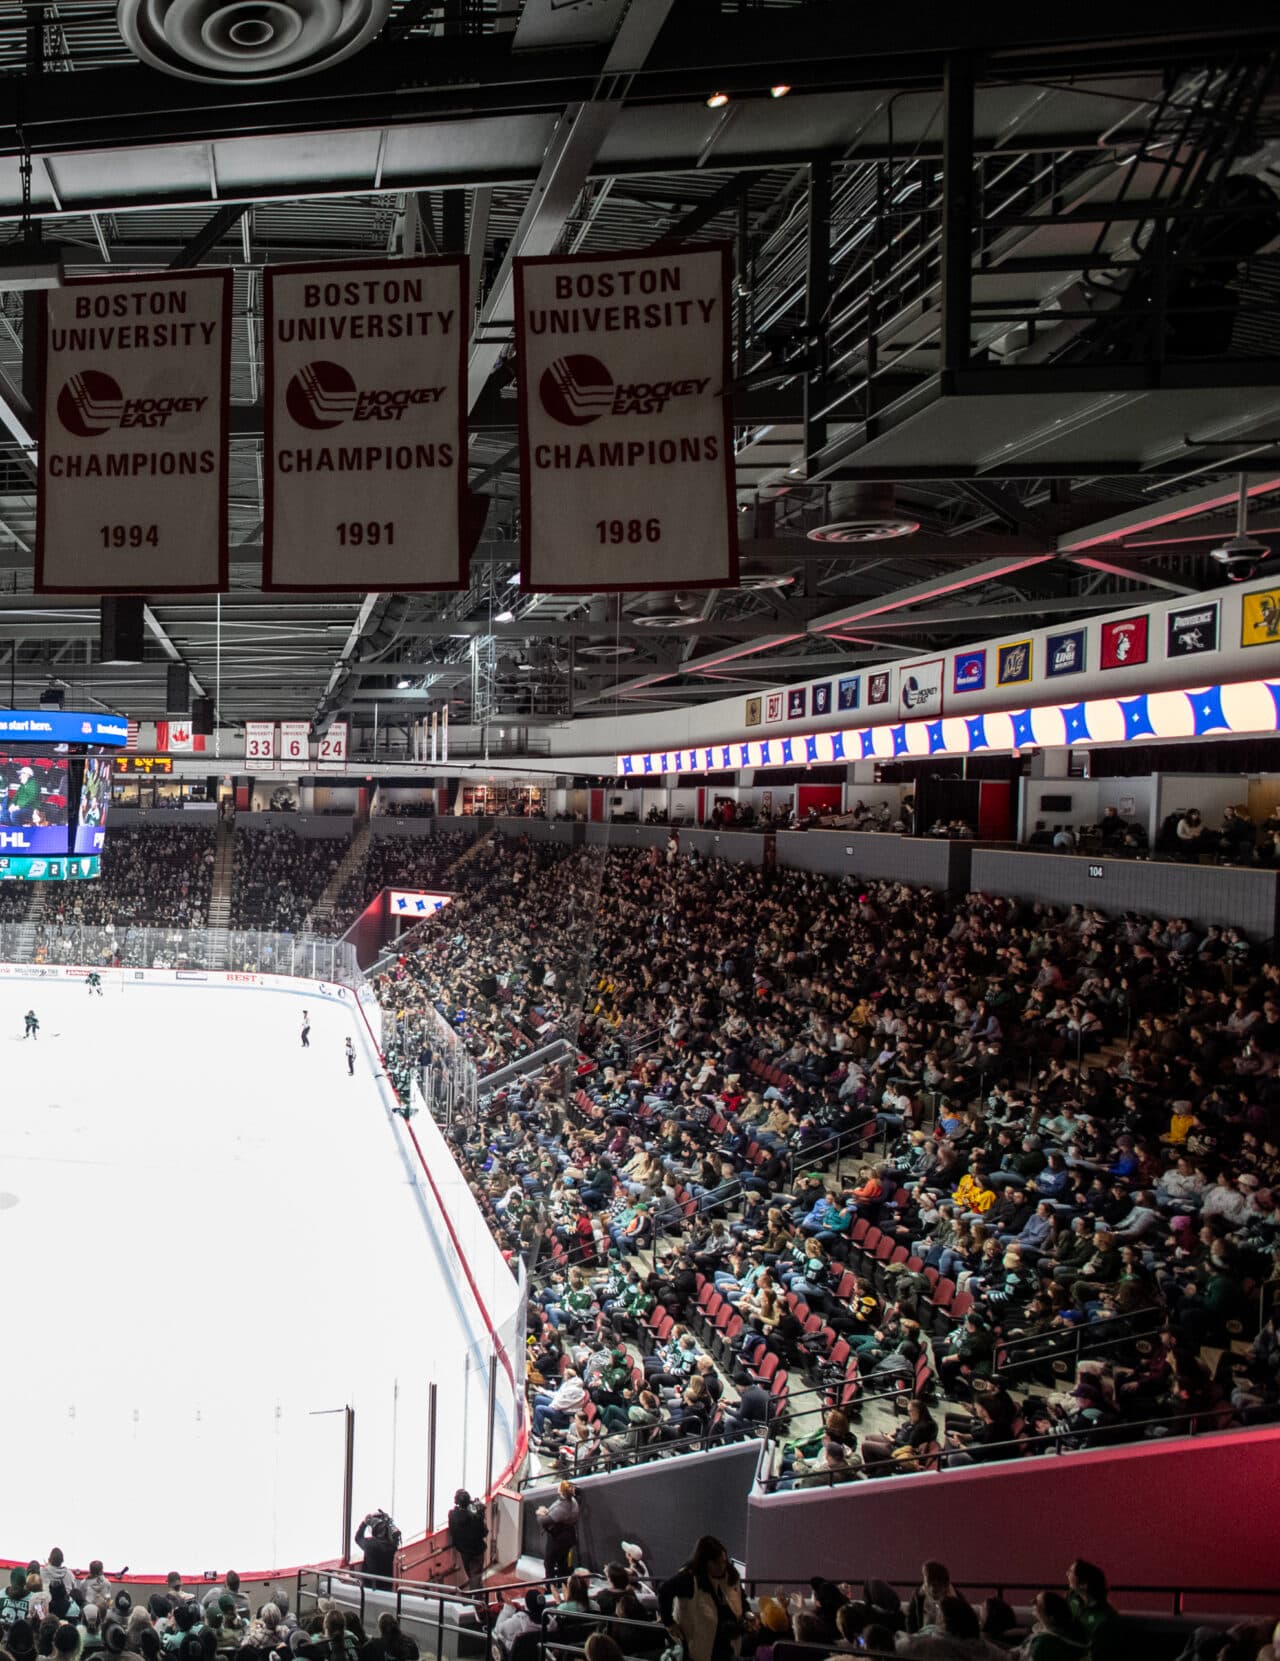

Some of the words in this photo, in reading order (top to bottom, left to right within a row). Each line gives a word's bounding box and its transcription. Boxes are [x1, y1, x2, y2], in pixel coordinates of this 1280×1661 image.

[304, 279, 422, 308] BOSTON
[555, 267, 681, 300] BOSTON
[75, 290, 187, 319] BOSTON
[278, 310, 454, 343] UNIVERSITY
[529, 298, 716, 335] UNIVERSITY
[51, 321, 216, 352] UNIVERSITY
[356, 387, 448, 405] HOCKEY
[615, 377, 711, 400] HOCKEY
[121, 396, 208, 414] HOCKEY
[352, 404, 409, 421] EAST
[611, 399, 669, 416] EAST
[119, 411, 171, 428] EAST
[49, 449, 215, 478] CHAMPIONS
[278, 443, 453, 473] CHAMPIONS
[534, 435, 719, 469] CHAMPIONS
[100, 524, 159, 548] 1994
[336, 521, 395, 546] 1991
[595, 517, 661, 545] 1986
[8, 721, 28, 731] start
[250, 740, 271, 756] 33
[290, 740, 300, 756] 6
[321, 740, 342, 756] 24
[51, 864, 58, 875] 2
[1090, 866, 1103, 876] 104
[226, 973, 257, 982] BEST
